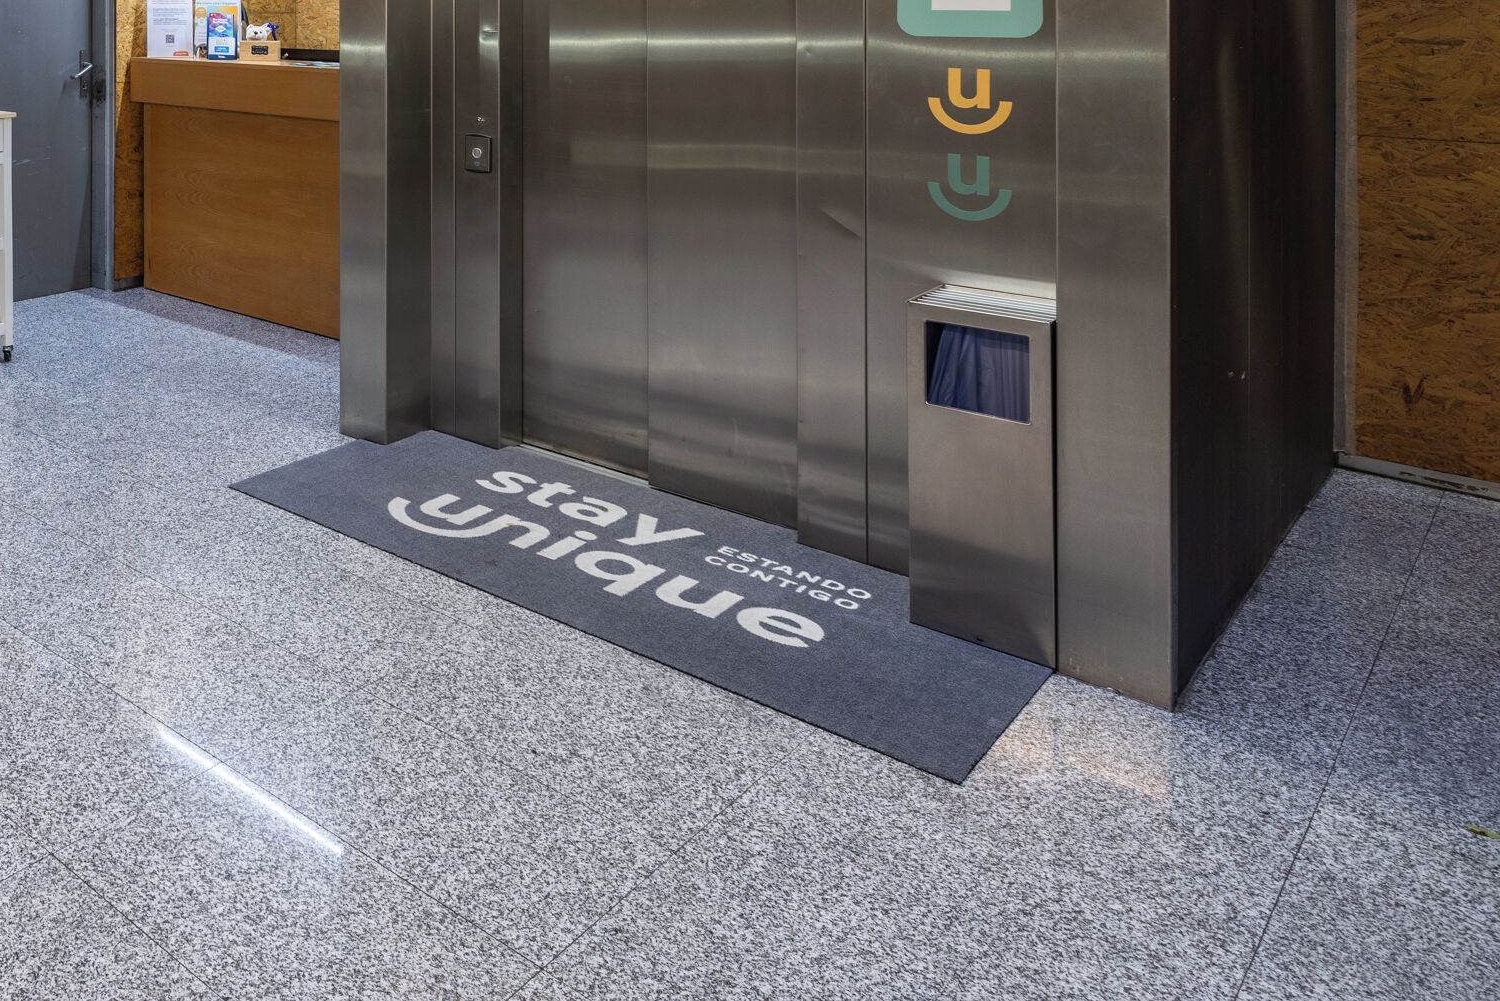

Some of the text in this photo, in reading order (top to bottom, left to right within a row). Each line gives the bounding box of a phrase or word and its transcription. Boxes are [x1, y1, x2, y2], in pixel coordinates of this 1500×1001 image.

[475, 470, 705, 547] stay
[388, 493, 825, 649] unique
[704, 555, 860, 610] CONTIGO
[717, 545, 872, 600] ESTANDO
